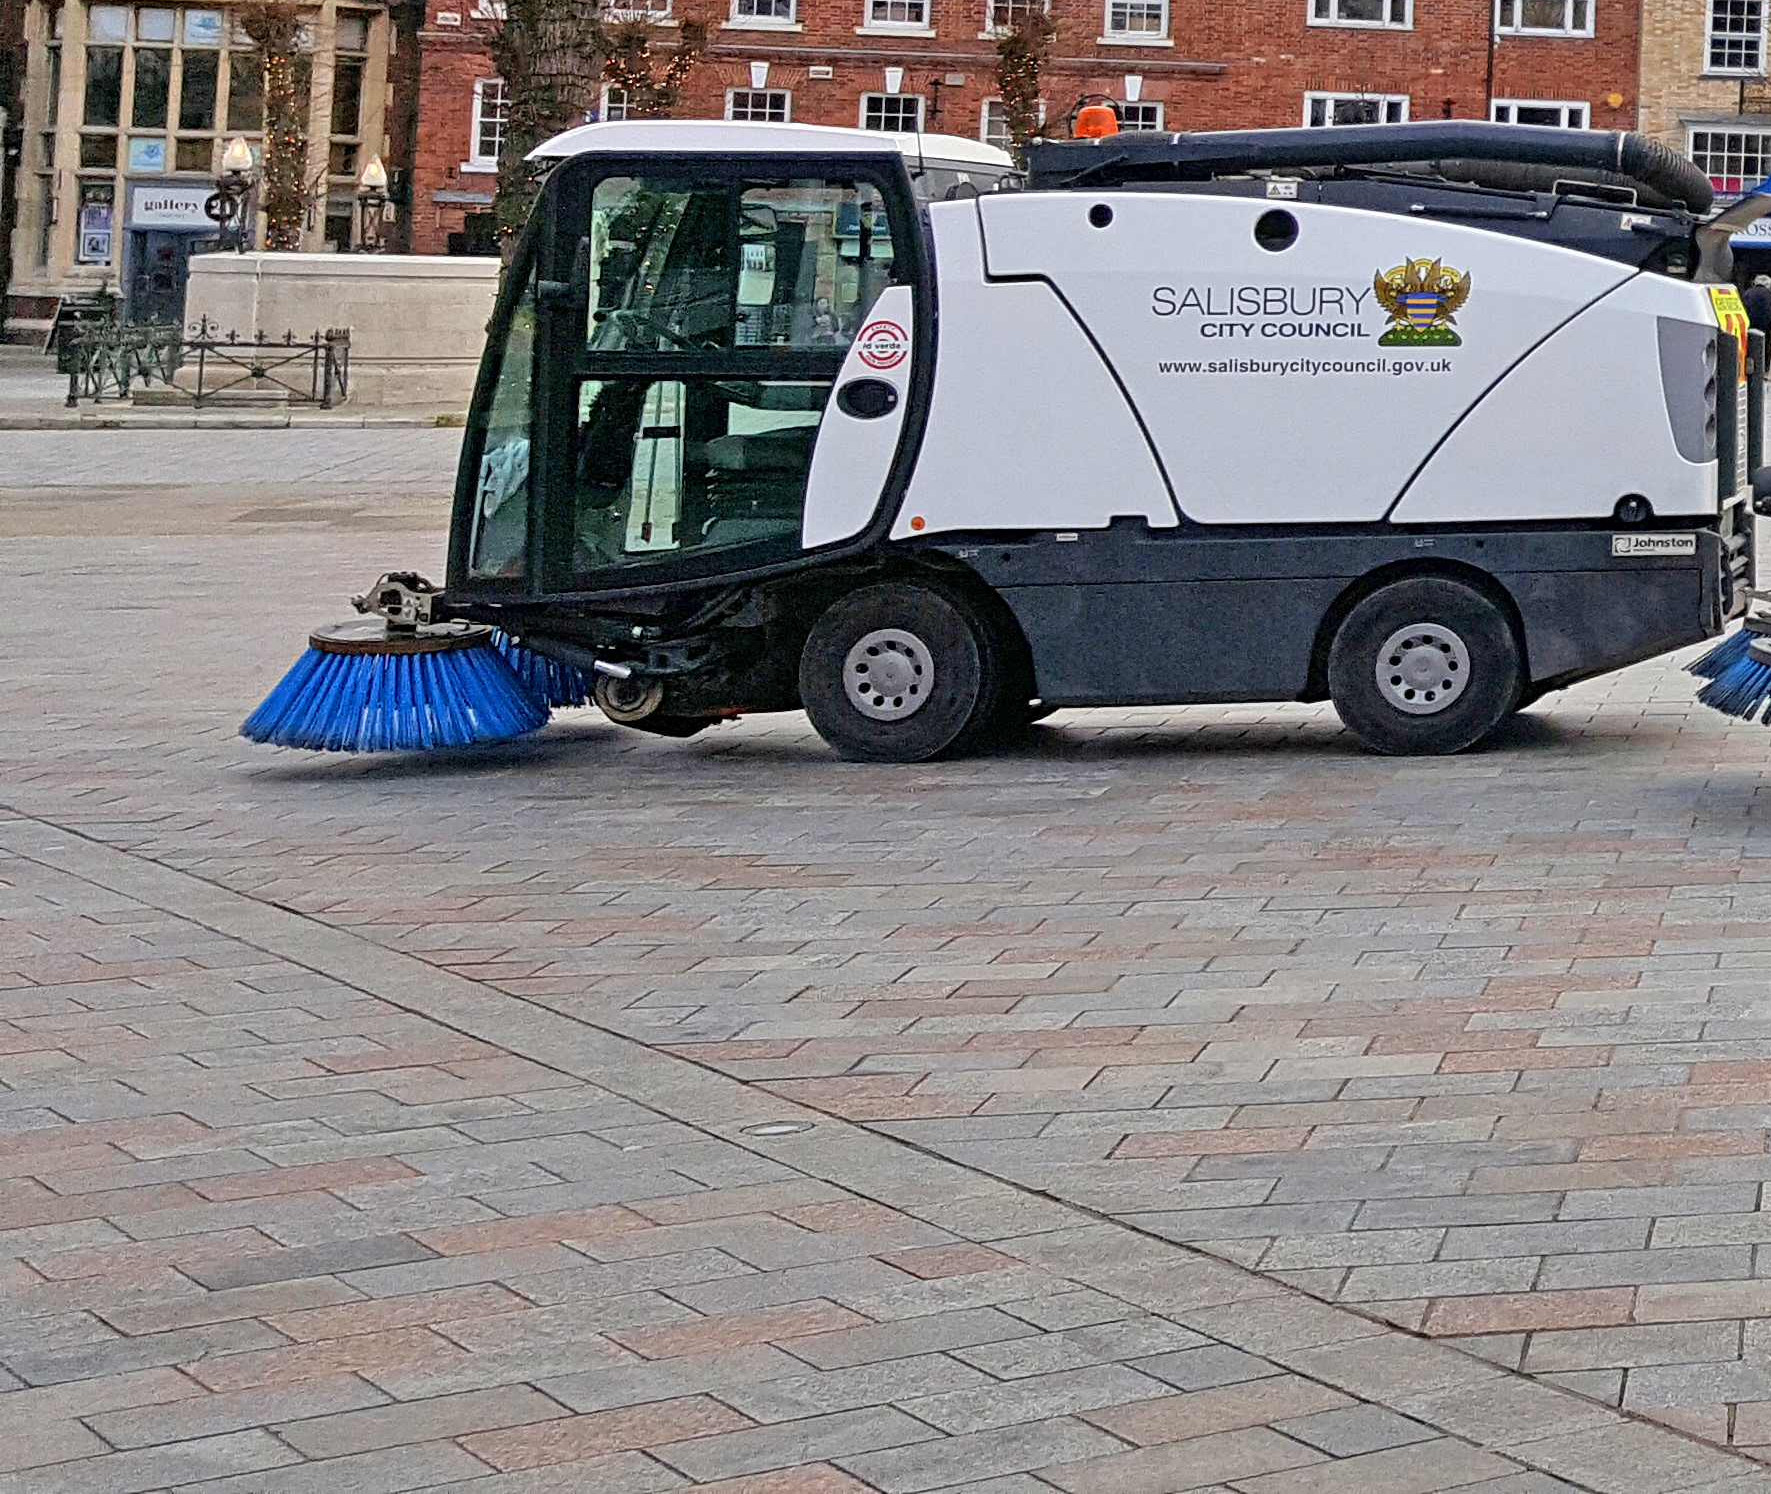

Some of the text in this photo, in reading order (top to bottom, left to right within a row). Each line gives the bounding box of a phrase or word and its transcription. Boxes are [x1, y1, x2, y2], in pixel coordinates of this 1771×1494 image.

[144, 198, 199, 213] gallery
[1152, 287, 1371, 316] SALISBURY
[1200, 323, 1370, 338] CITY COUNCIL
[1159, 359, 1452, 376] www.salisburycitycouncil.gov.uk
[1633, 537, 1693, 548] Johnston
